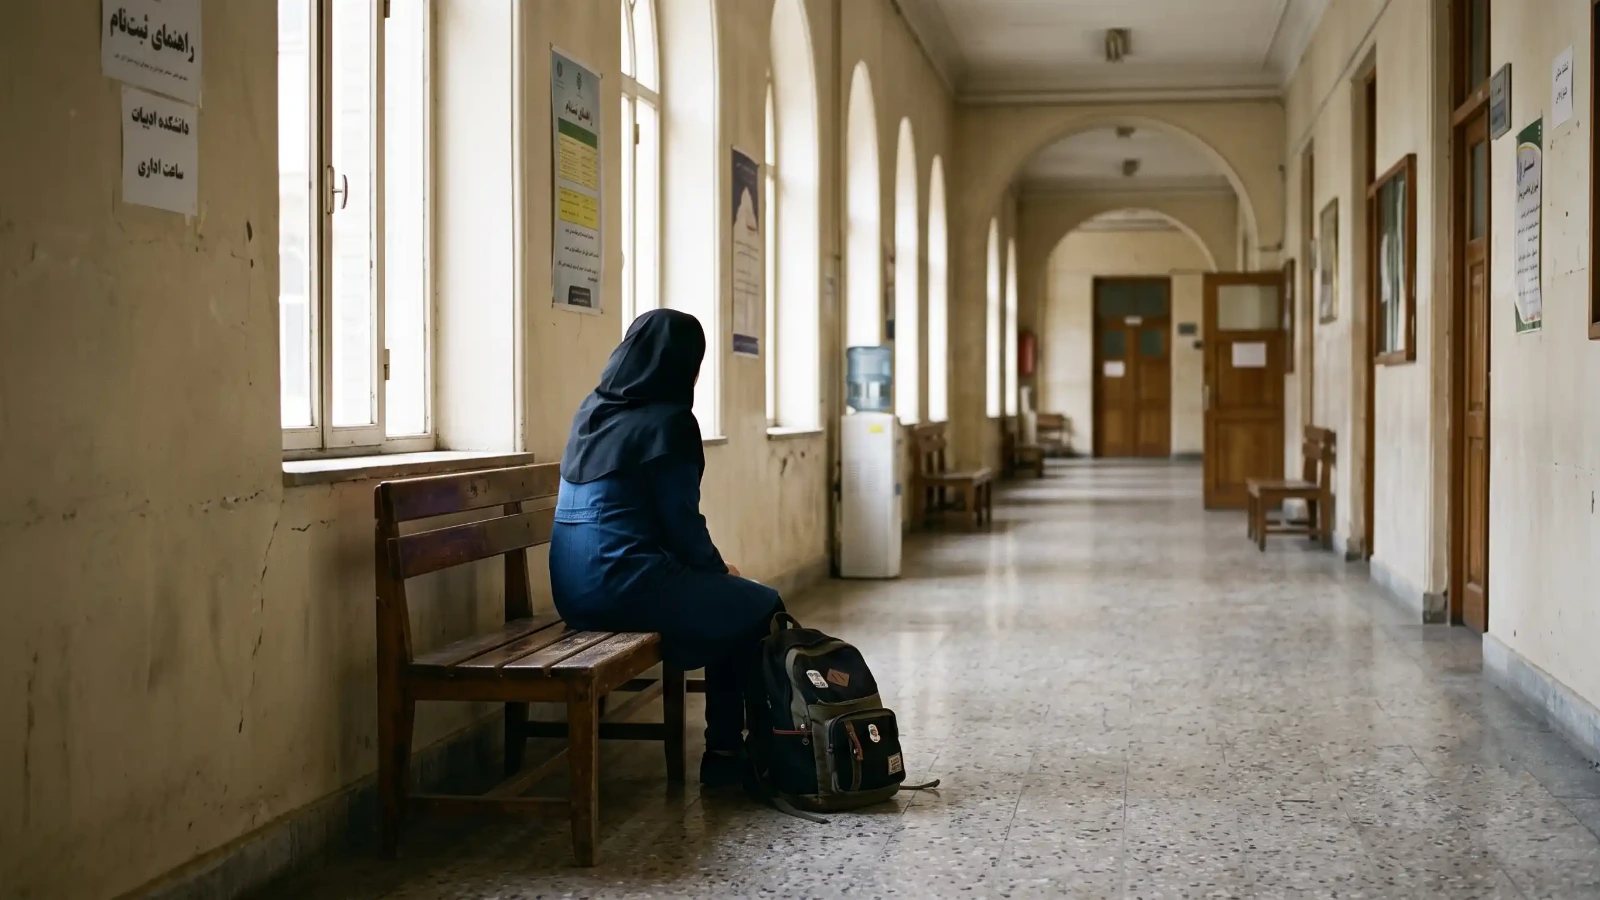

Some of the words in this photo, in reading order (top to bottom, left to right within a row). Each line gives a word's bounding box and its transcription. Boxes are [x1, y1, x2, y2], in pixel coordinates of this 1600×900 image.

[151, 23, 195, 64] راهنمای
[131, 106, 157, 130] ادبیات
[159, 116, 190, 136] دانشکده
[138, 157, 161, 179] اداری
[163, 163, 184, 180] ساعت
